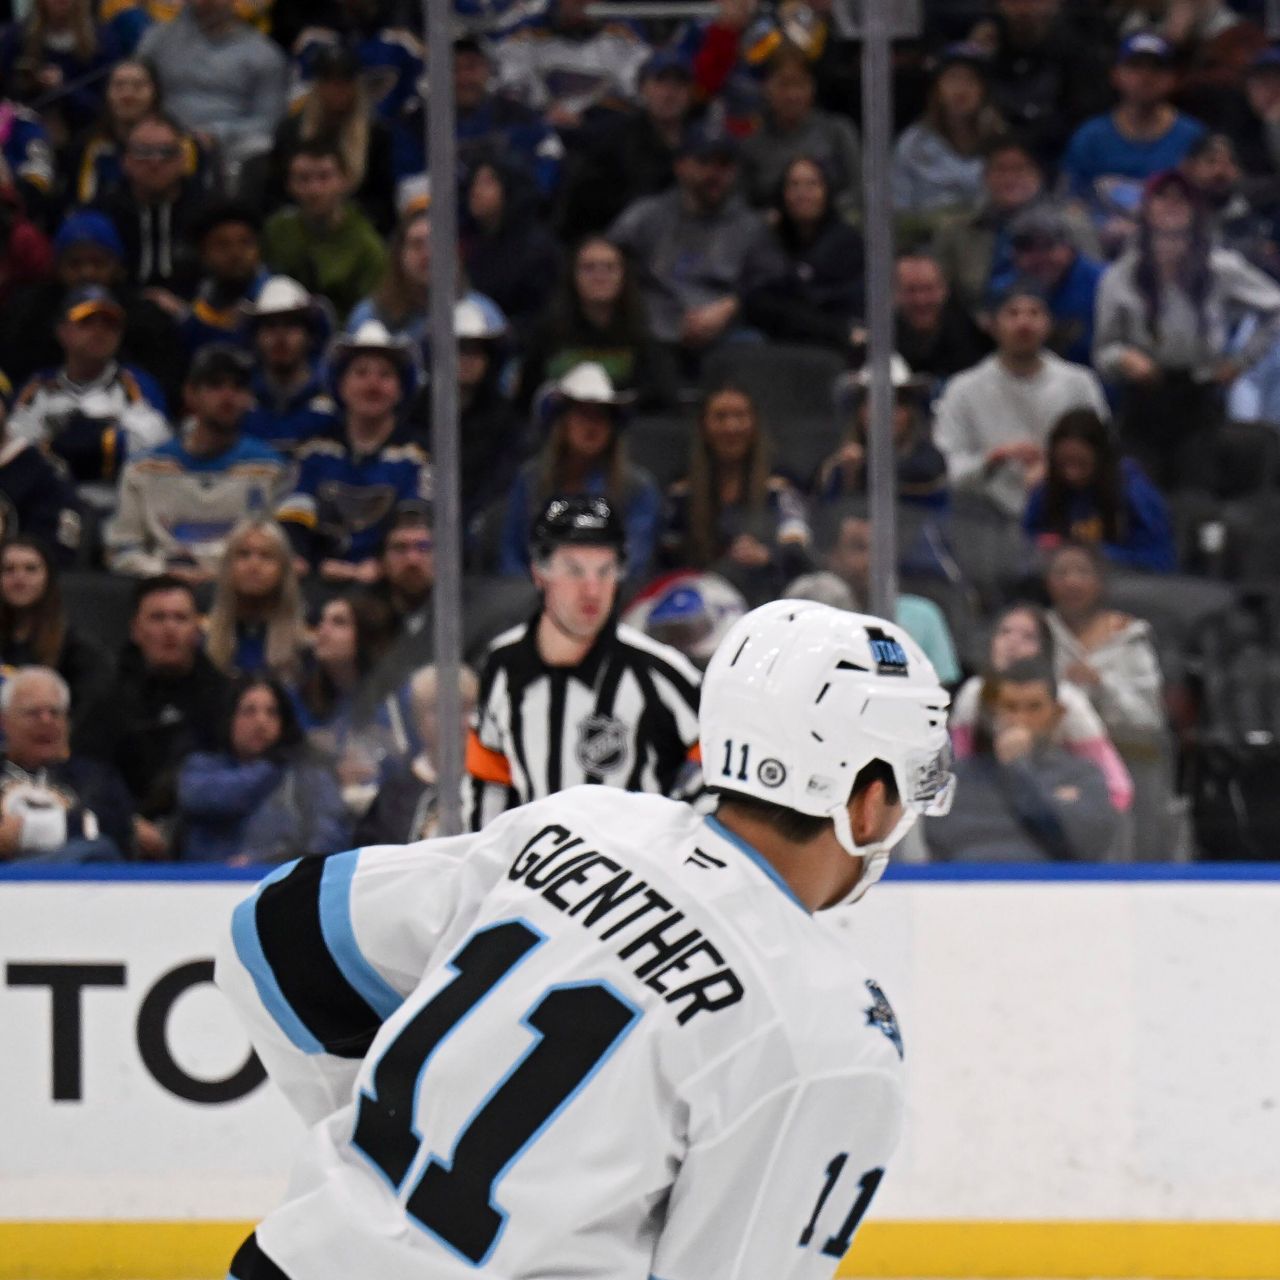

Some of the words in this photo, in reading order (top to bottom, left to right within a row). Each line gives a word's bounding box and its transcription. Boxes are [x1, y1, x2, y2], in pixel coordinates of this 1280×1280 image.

[721, 739, 750, 781] 11
[508, 824, 745, 1028] GUENTHER
[349, 914, 646, 1269] 11
[797, 1151, 886, 1259] 11
